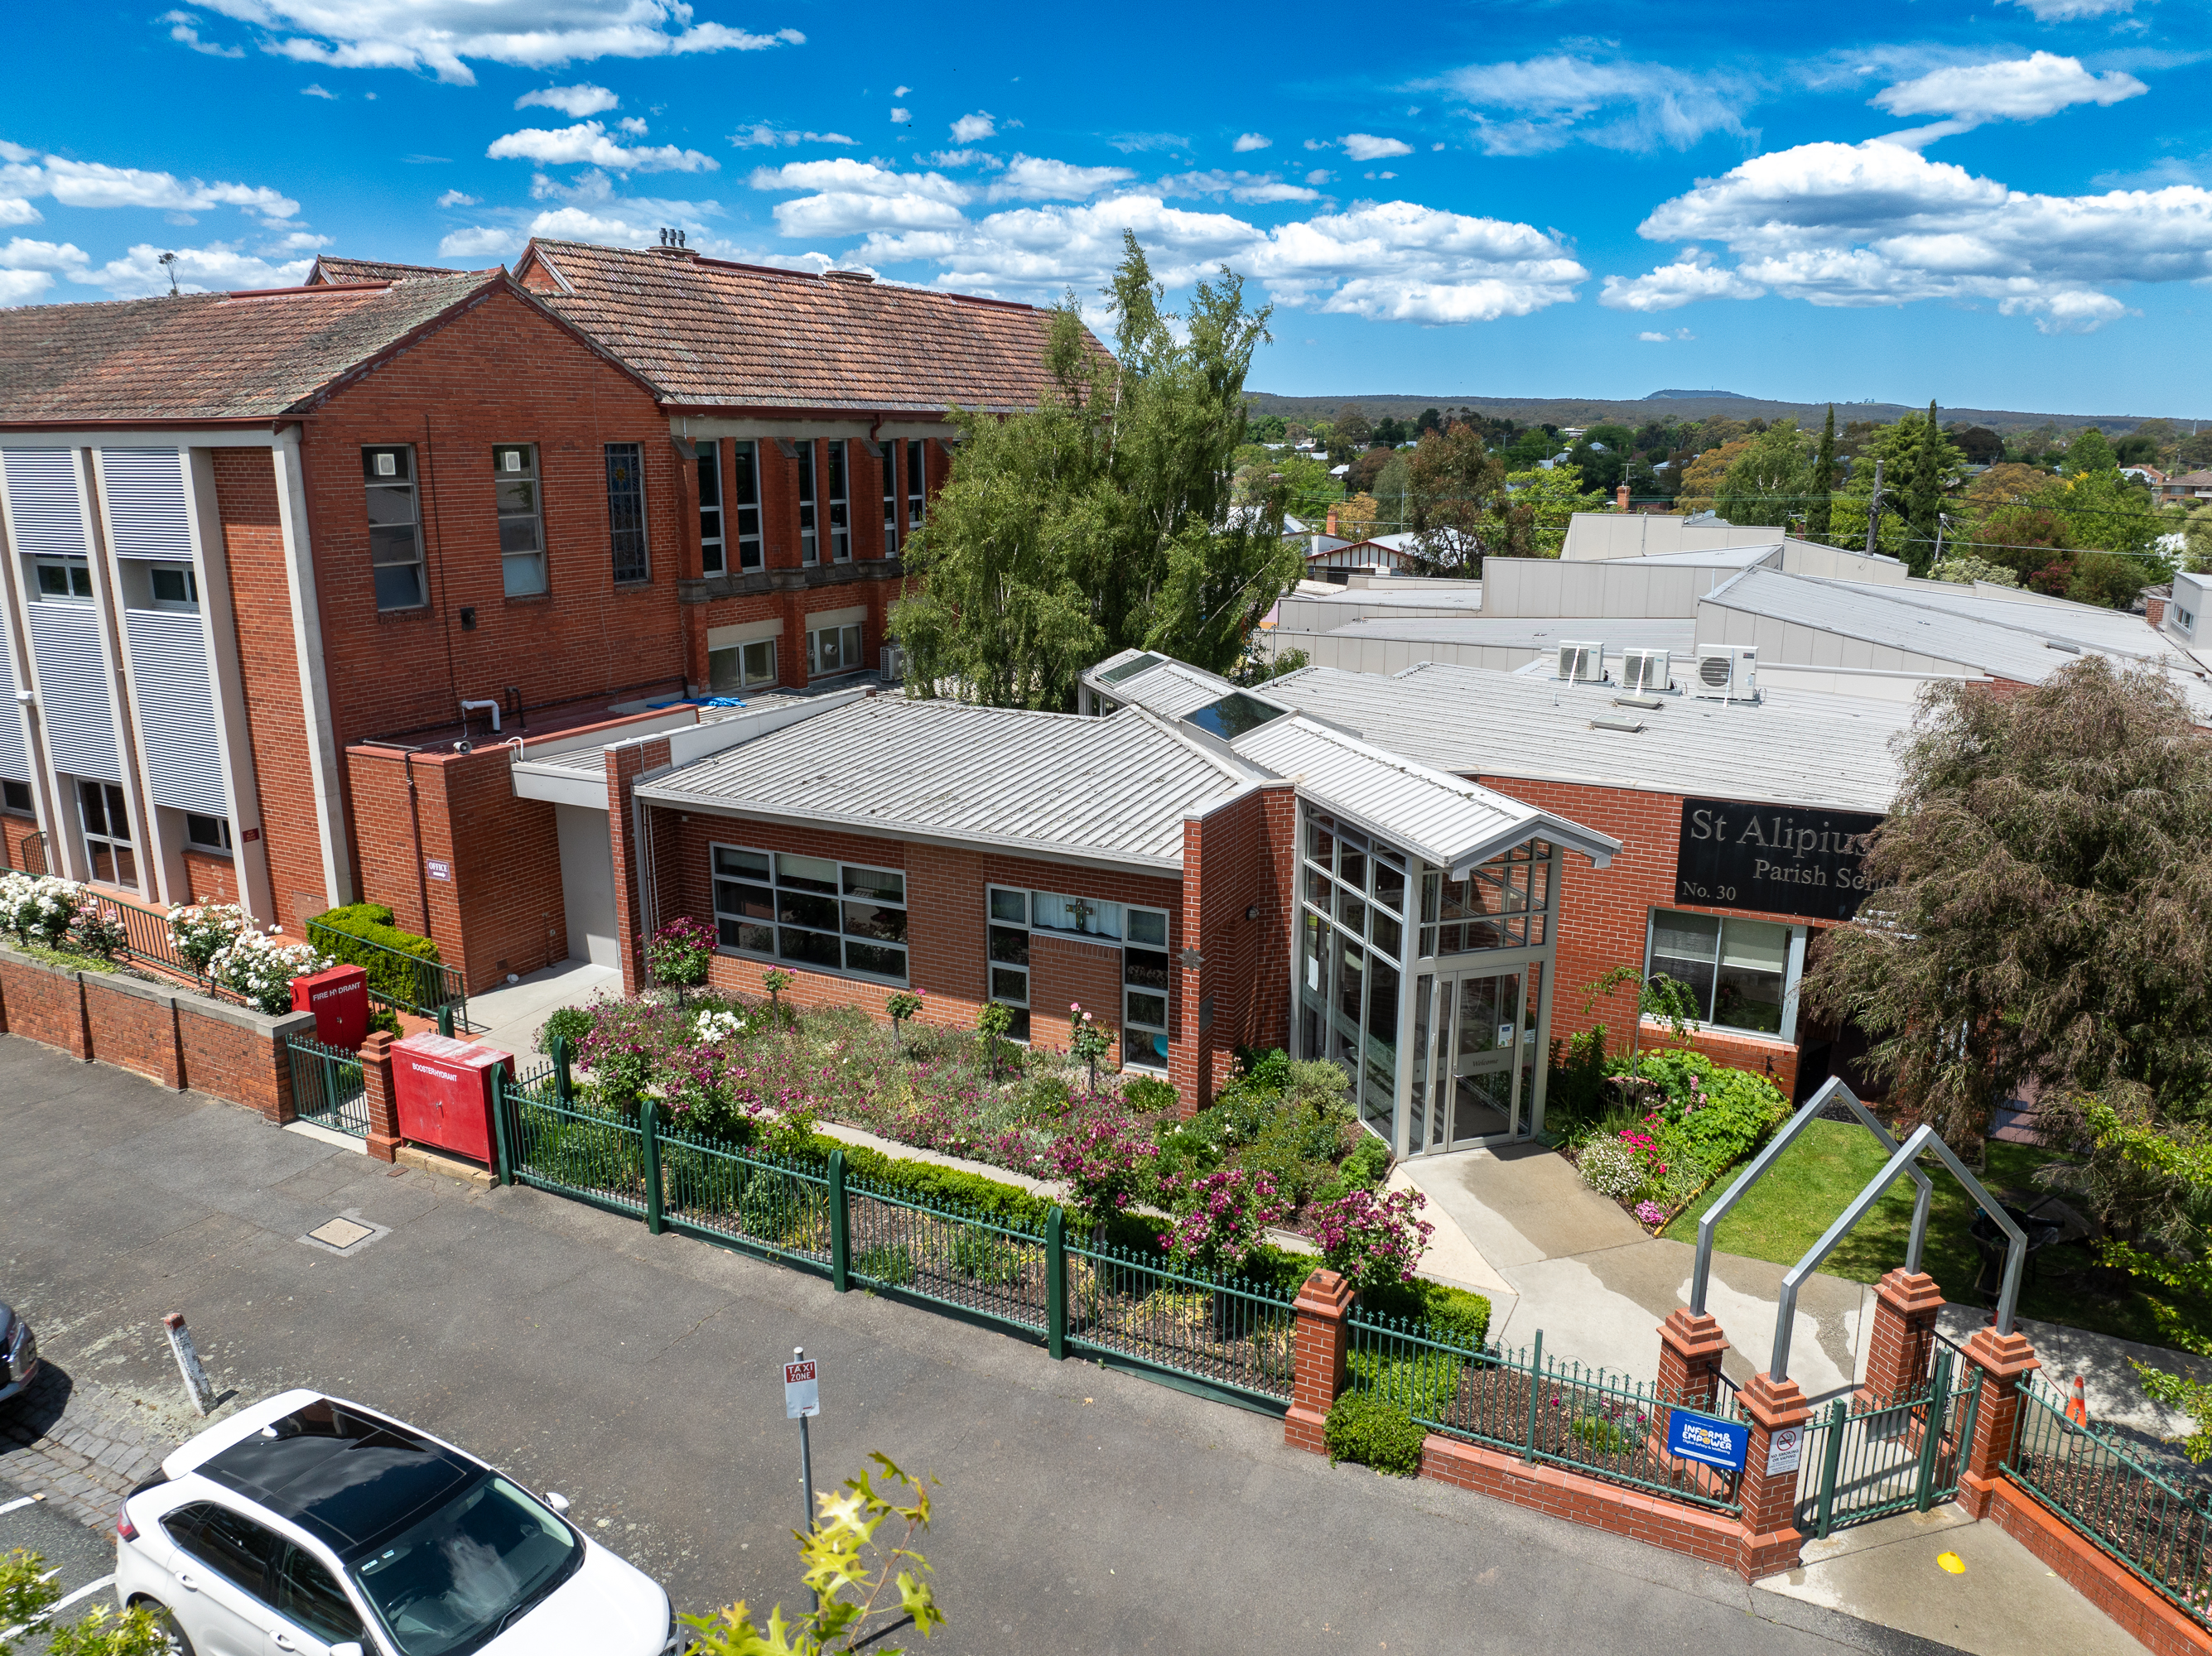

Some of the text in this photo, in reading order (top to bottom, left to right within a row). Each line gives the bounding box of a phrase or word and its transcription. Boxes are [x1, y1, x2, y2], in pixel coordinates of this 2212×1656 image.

[1691, 810, 1872, 859] St Alipius
[429, 862, 447, 872] OFFICE
[1752, 859, 1828, 886] Parish
[1683, 881, 1737, 901] No. 30
[313, 990, 328, 1001] FIRE
[1472, 1058, 1498, 1066] Welcome
[788, 1363, 813, 1374] TAXI
[791, 1371, 812, 1381] ZONE
[1778, 1449, 1799, 1457] SMOKING
